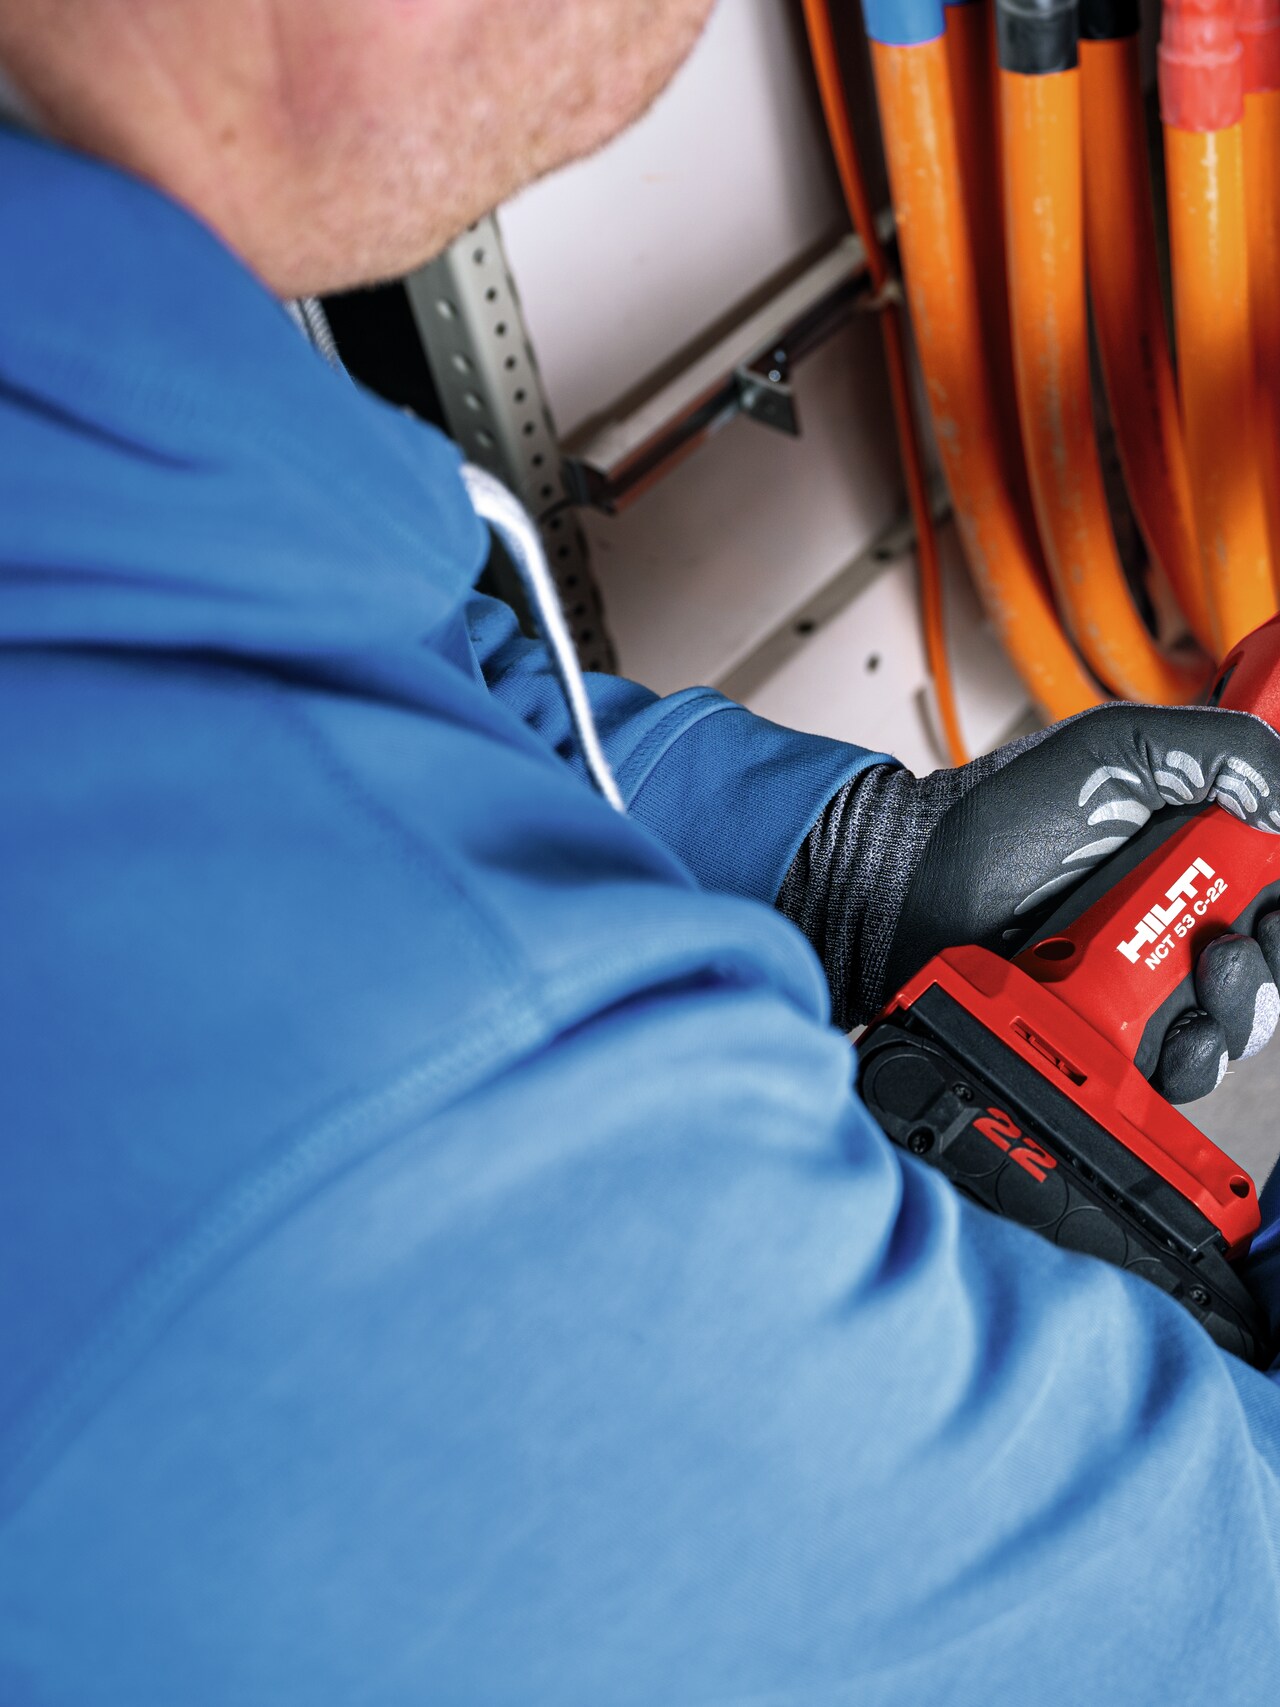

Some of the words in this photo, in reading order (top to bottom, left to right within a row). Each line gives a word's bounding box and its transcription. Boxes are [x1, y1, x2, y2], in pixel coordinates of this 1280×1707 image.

[1117, 857, 1216, 964] HILTI
[1144, 934, 1176, 971] NCT
[1173, 913, 1196, 938] 53
[1193, 877, 1229, 915] C-22
[973, 1106, 1058, 1184] 22
